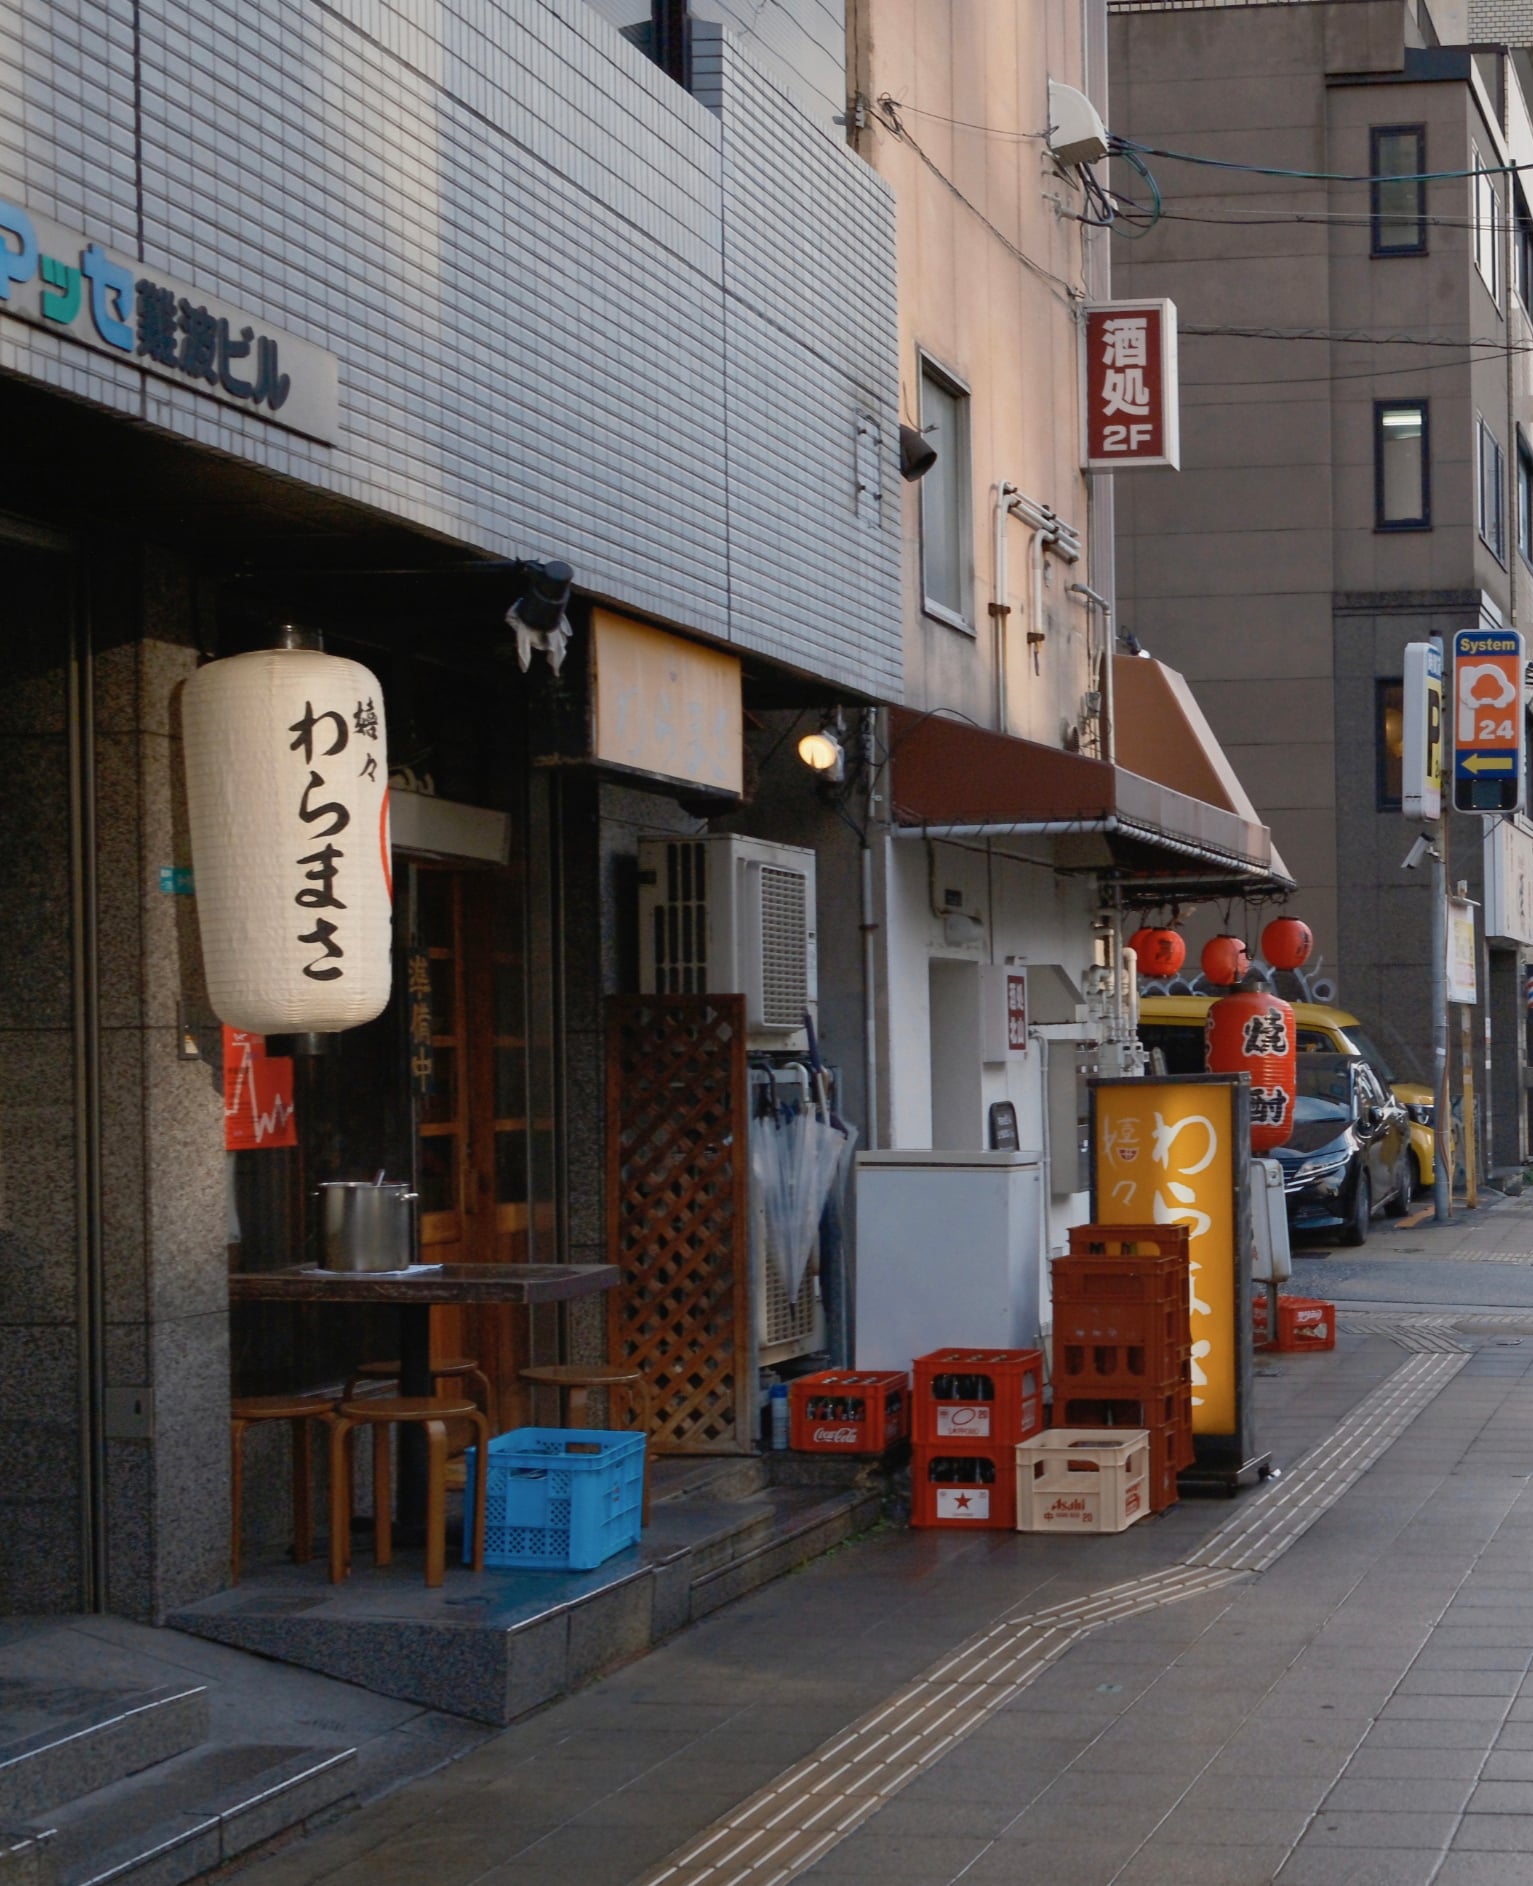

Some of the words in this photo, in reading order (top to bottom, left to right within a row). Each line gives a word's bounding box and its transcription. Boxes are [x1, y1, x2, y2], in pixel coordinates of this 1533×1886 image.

[1102, 318, 1150, 416] 酒処
[1103, 424, 1153, 451] 2F
[1460, 638, 1516, 654] System
[1478, 719, 1515, 740] 24
[288, 700, 351, 981] わらまさ
[408, 954, 433, 1094] 準備中
[1243, 1008, 1288, 1125] 焼酎
[1051, 1498, 1085, 1510] Asahi
